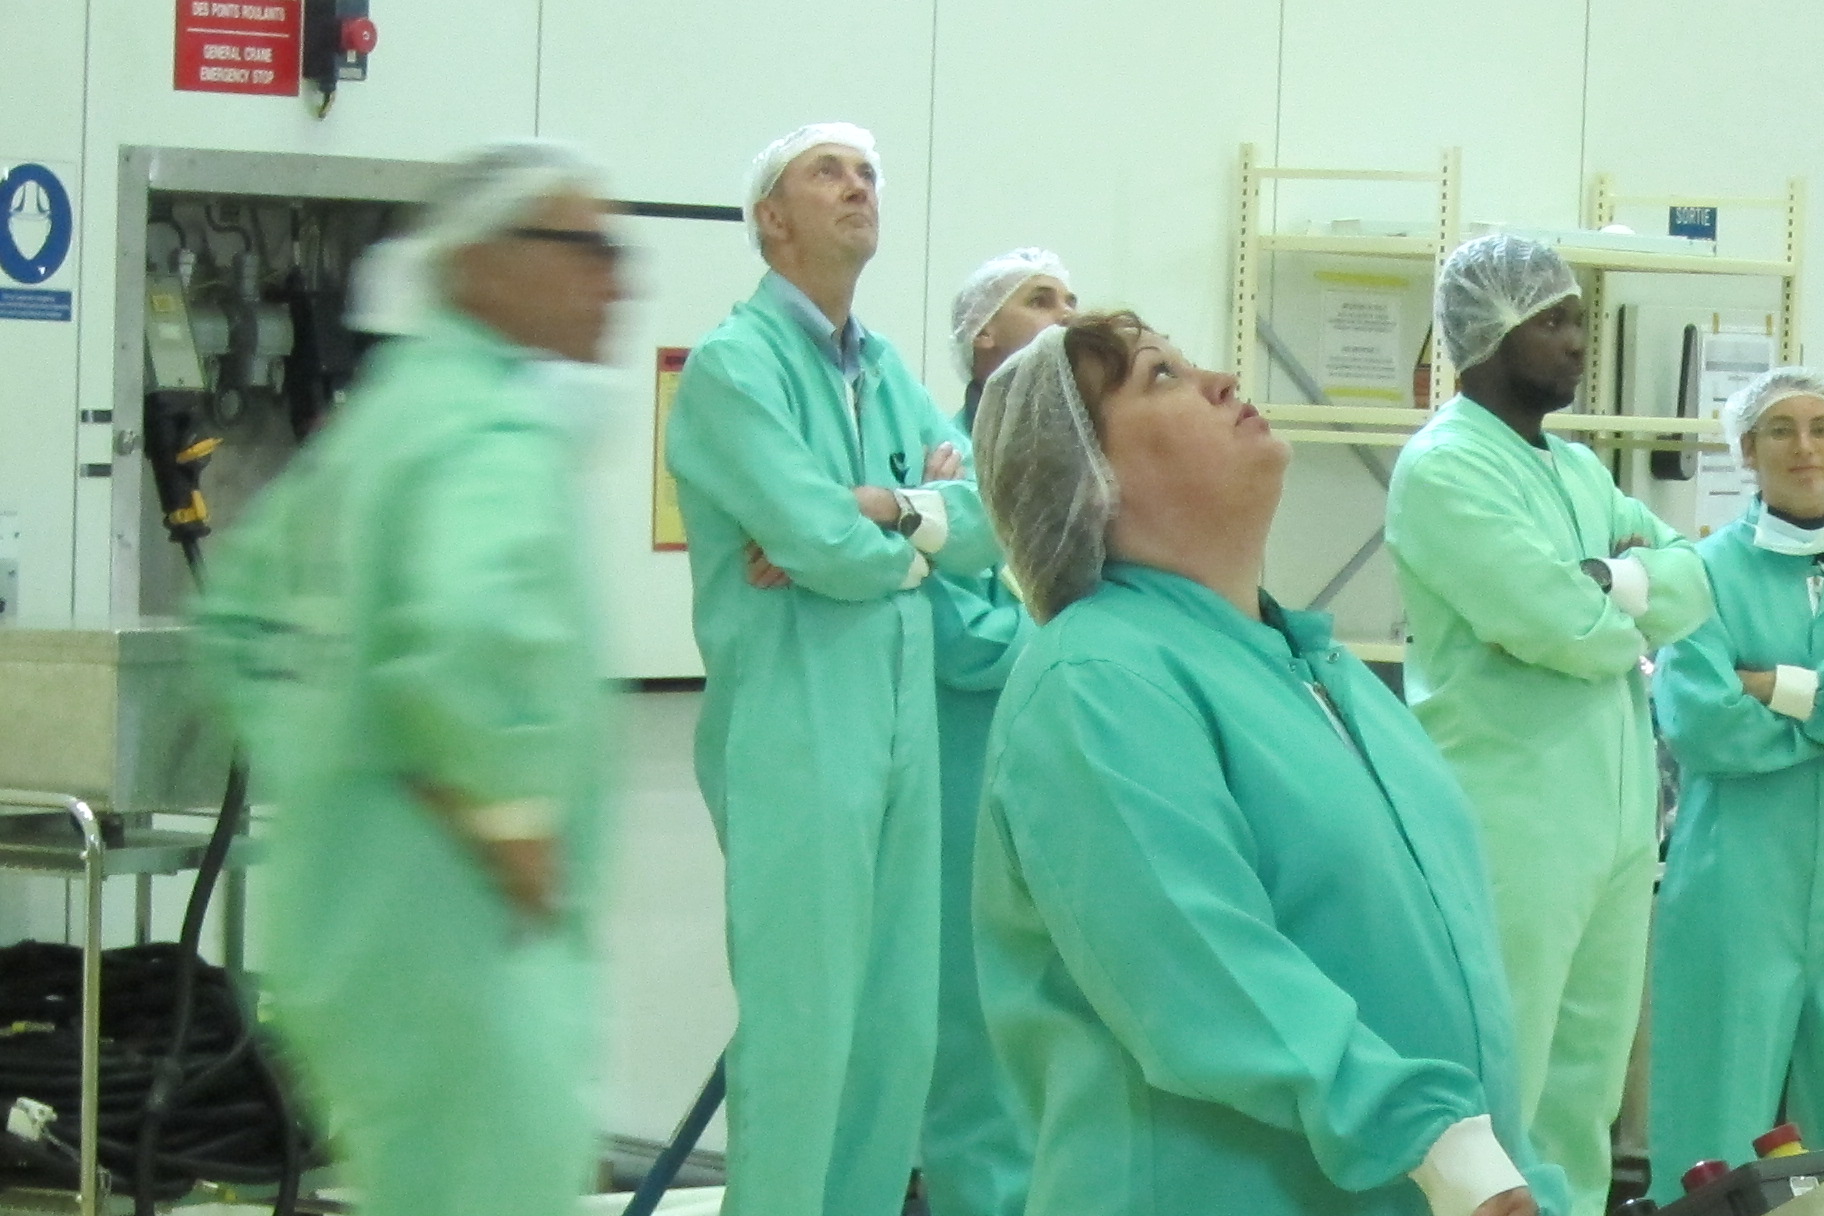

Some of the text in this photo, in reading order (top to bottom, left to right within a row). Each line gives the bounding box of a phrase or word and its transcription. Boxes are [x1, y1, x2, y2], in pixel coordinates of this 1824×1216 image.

[193, 1, 286, 22] DES PONTS ROULANTS
[203, 44, 273, 63] GENERAL CRANE
[200, 66, 275, 84] EMERGENCY STOP
[1675, 207, 1711, 226] SORTIE
